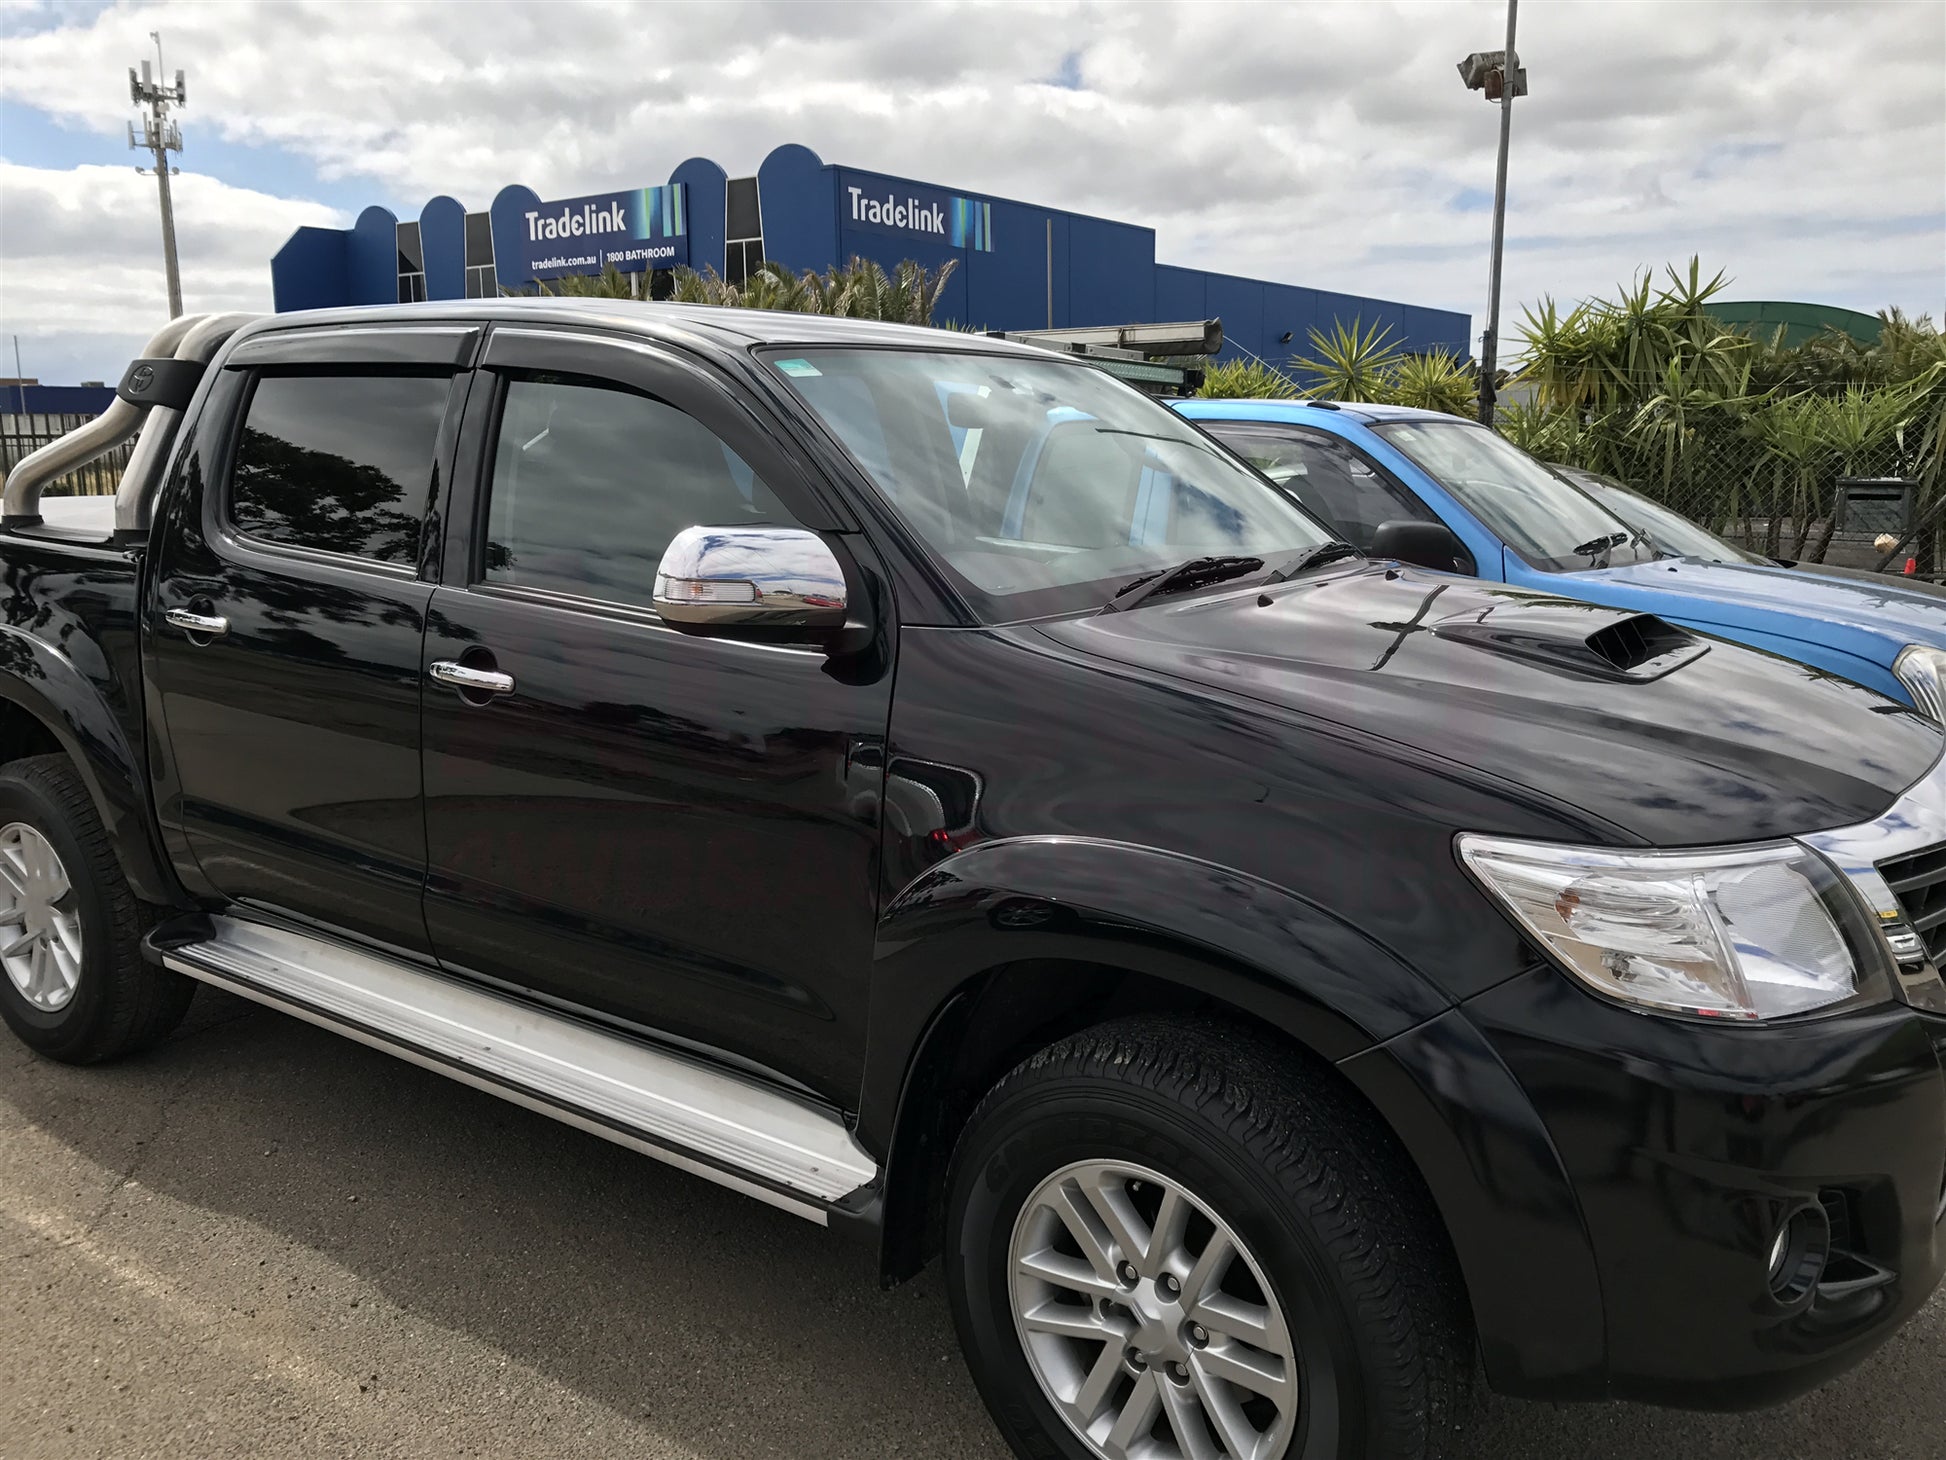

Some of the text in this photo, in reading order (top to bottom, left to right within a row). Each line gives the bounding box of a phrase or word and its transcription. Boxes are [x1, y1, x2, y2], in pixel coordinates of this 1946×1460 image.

[525, 201, 627, 241] Tradelink
[847, 186, 945, 234] Tradelink
[531, 246, 675, 270] tradelink.com.au 1800 BATHROOM
